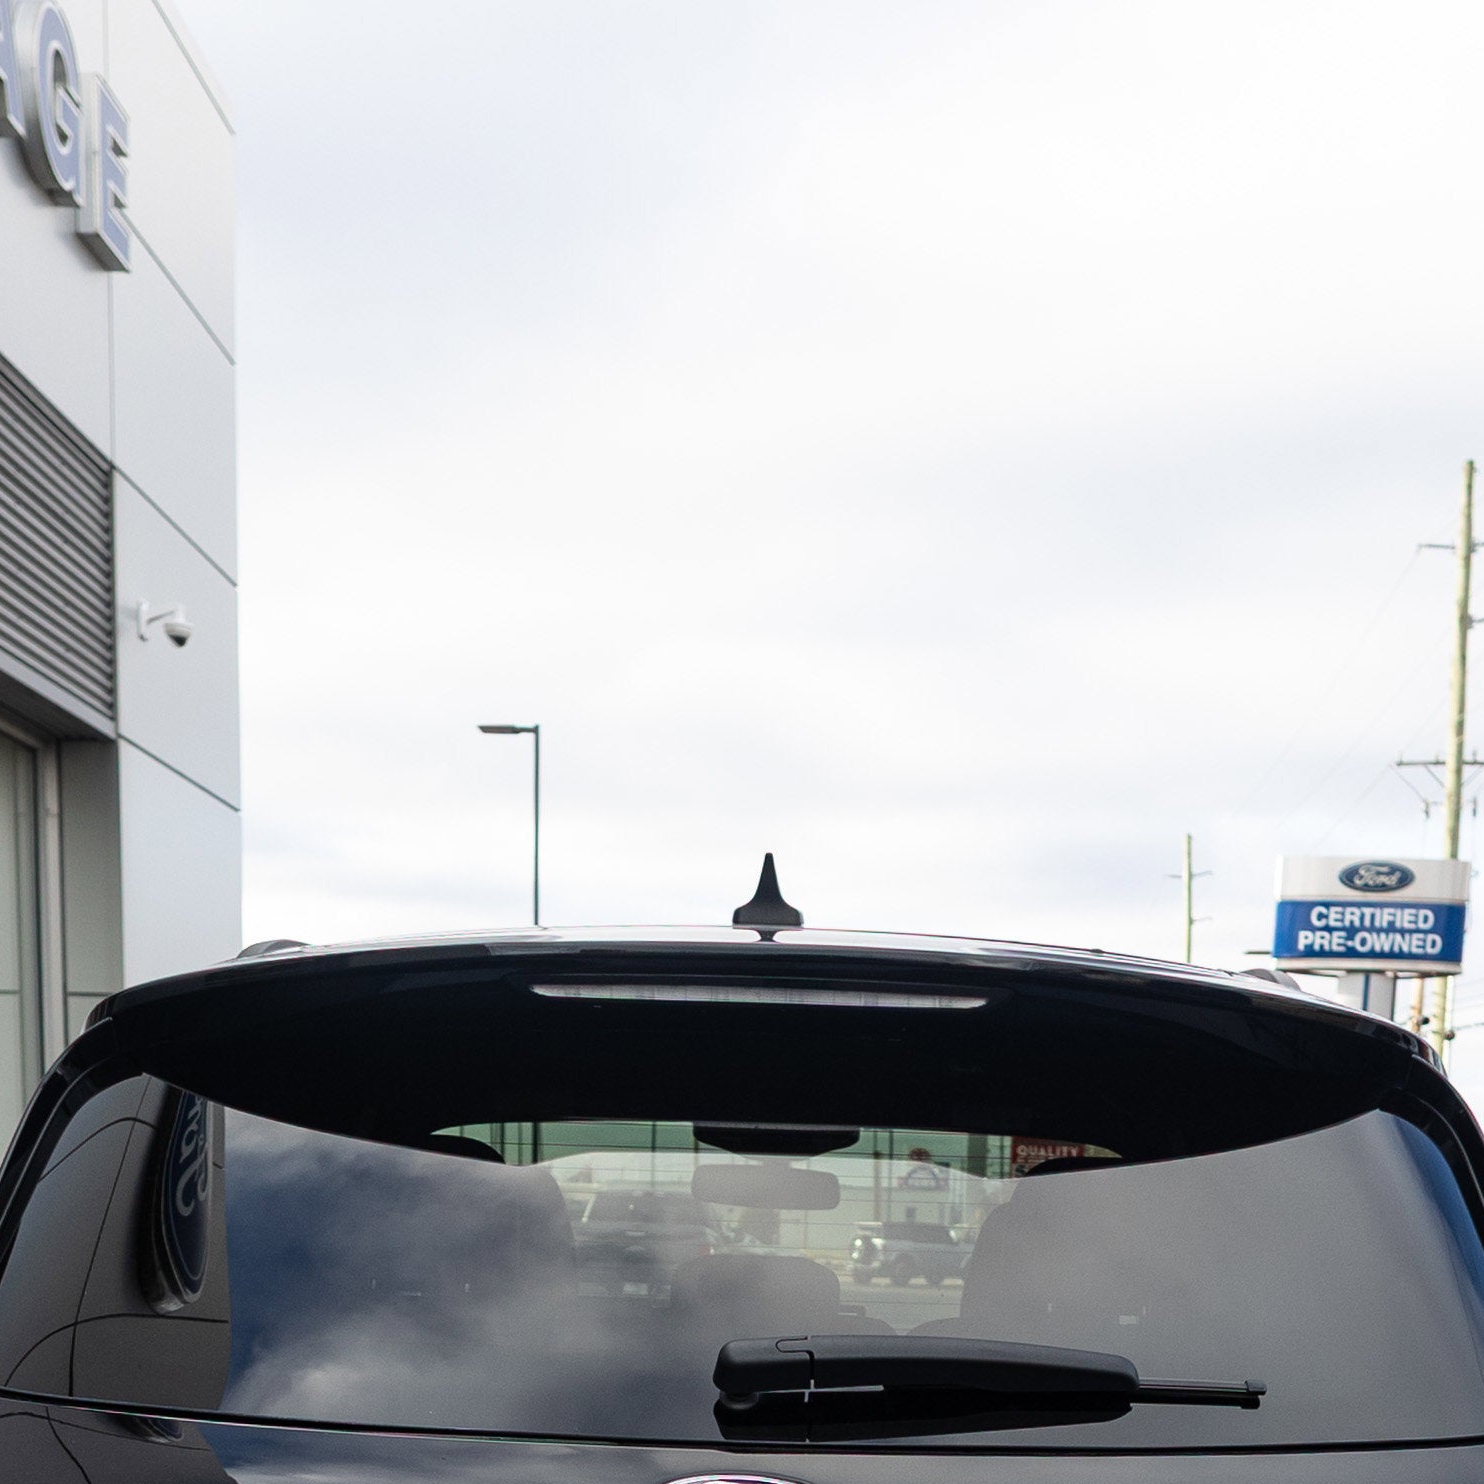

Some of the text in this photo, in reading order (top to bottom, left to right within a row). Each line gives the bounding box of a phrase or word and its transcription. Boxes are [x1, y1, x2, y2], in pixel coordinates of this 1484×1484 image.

[1353, 864, 1402, 888] Ford
[1309, 905, 1435, 930] CERTIFIED
[1297, 929, 1443, 955] PRE-OWNED
[1016, 1144, 1079, 1157] QUALITY
